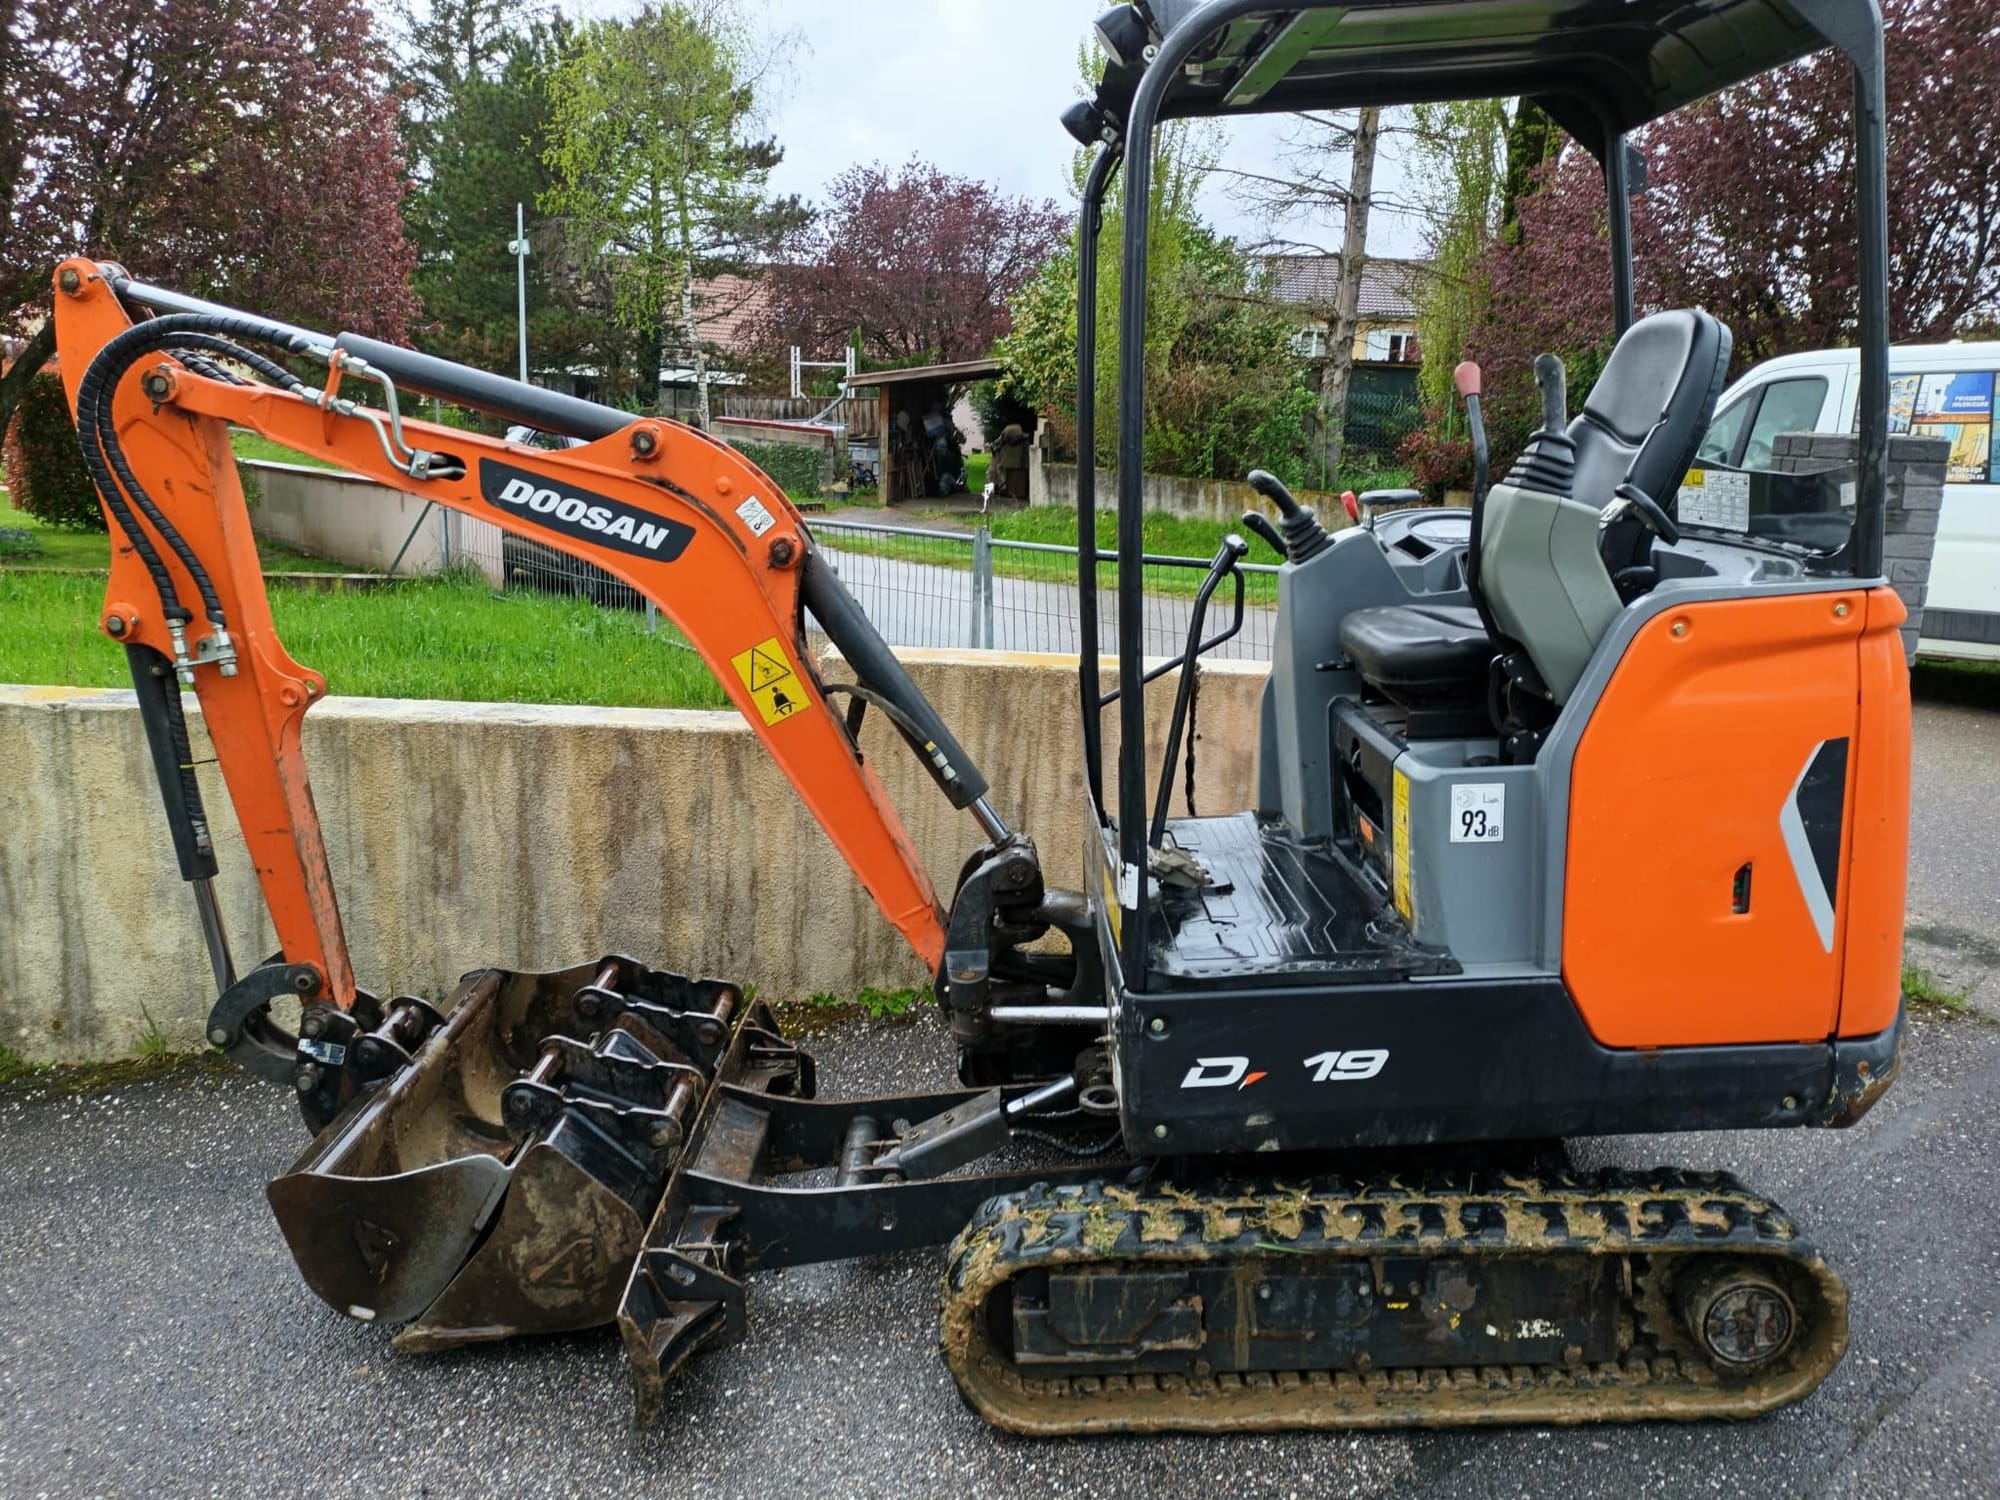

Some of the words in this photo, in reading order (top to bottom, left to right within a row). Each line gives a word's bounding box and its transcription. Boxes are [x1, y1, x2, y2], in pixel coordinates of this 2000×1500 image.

[498, 478, 670, 551] DOOSAN
[1462, 809, 1487, 838] 93
[1488, 825, 1499, 837] dB
[1180, 1056, 1268, 1092] D
[1303, 1049, 1389, 1082] 19
